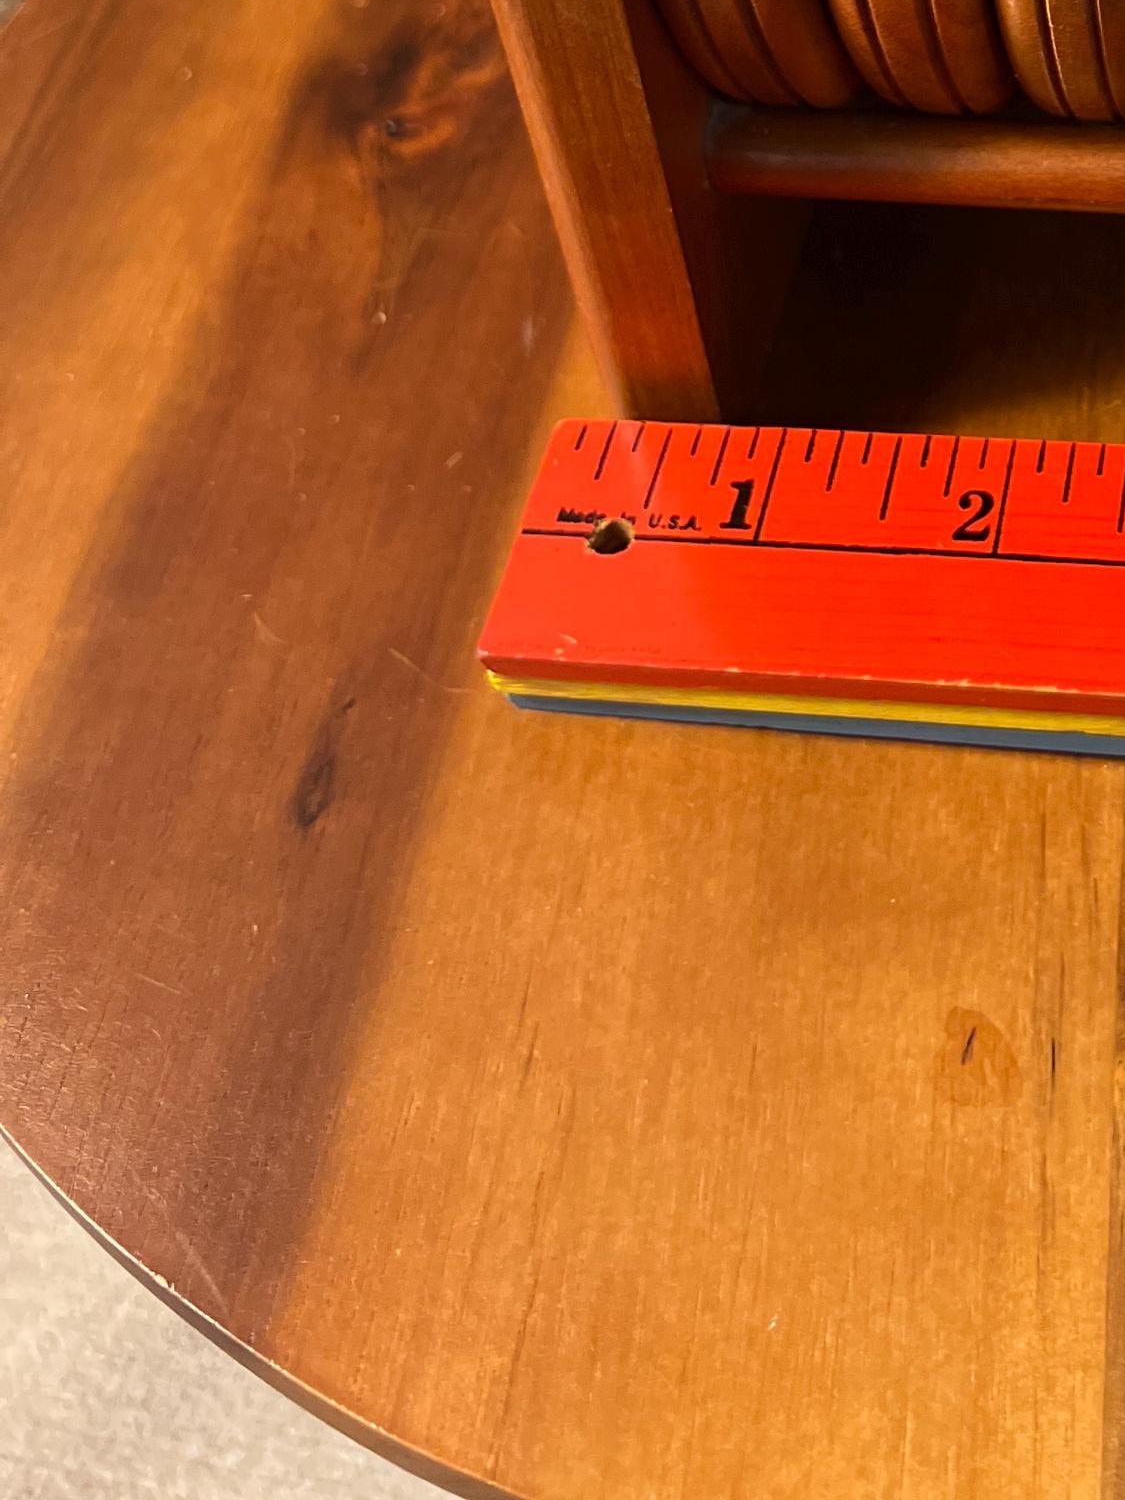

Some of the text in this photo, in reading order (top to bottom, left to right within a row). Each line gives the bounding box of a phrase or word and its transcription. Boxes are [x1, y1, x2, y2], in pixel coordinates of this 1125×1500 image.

[648, 513, 702, 532] U.S.A.
[719, 479, 754, 530] 1
[952, 490, 994, 542] 2
